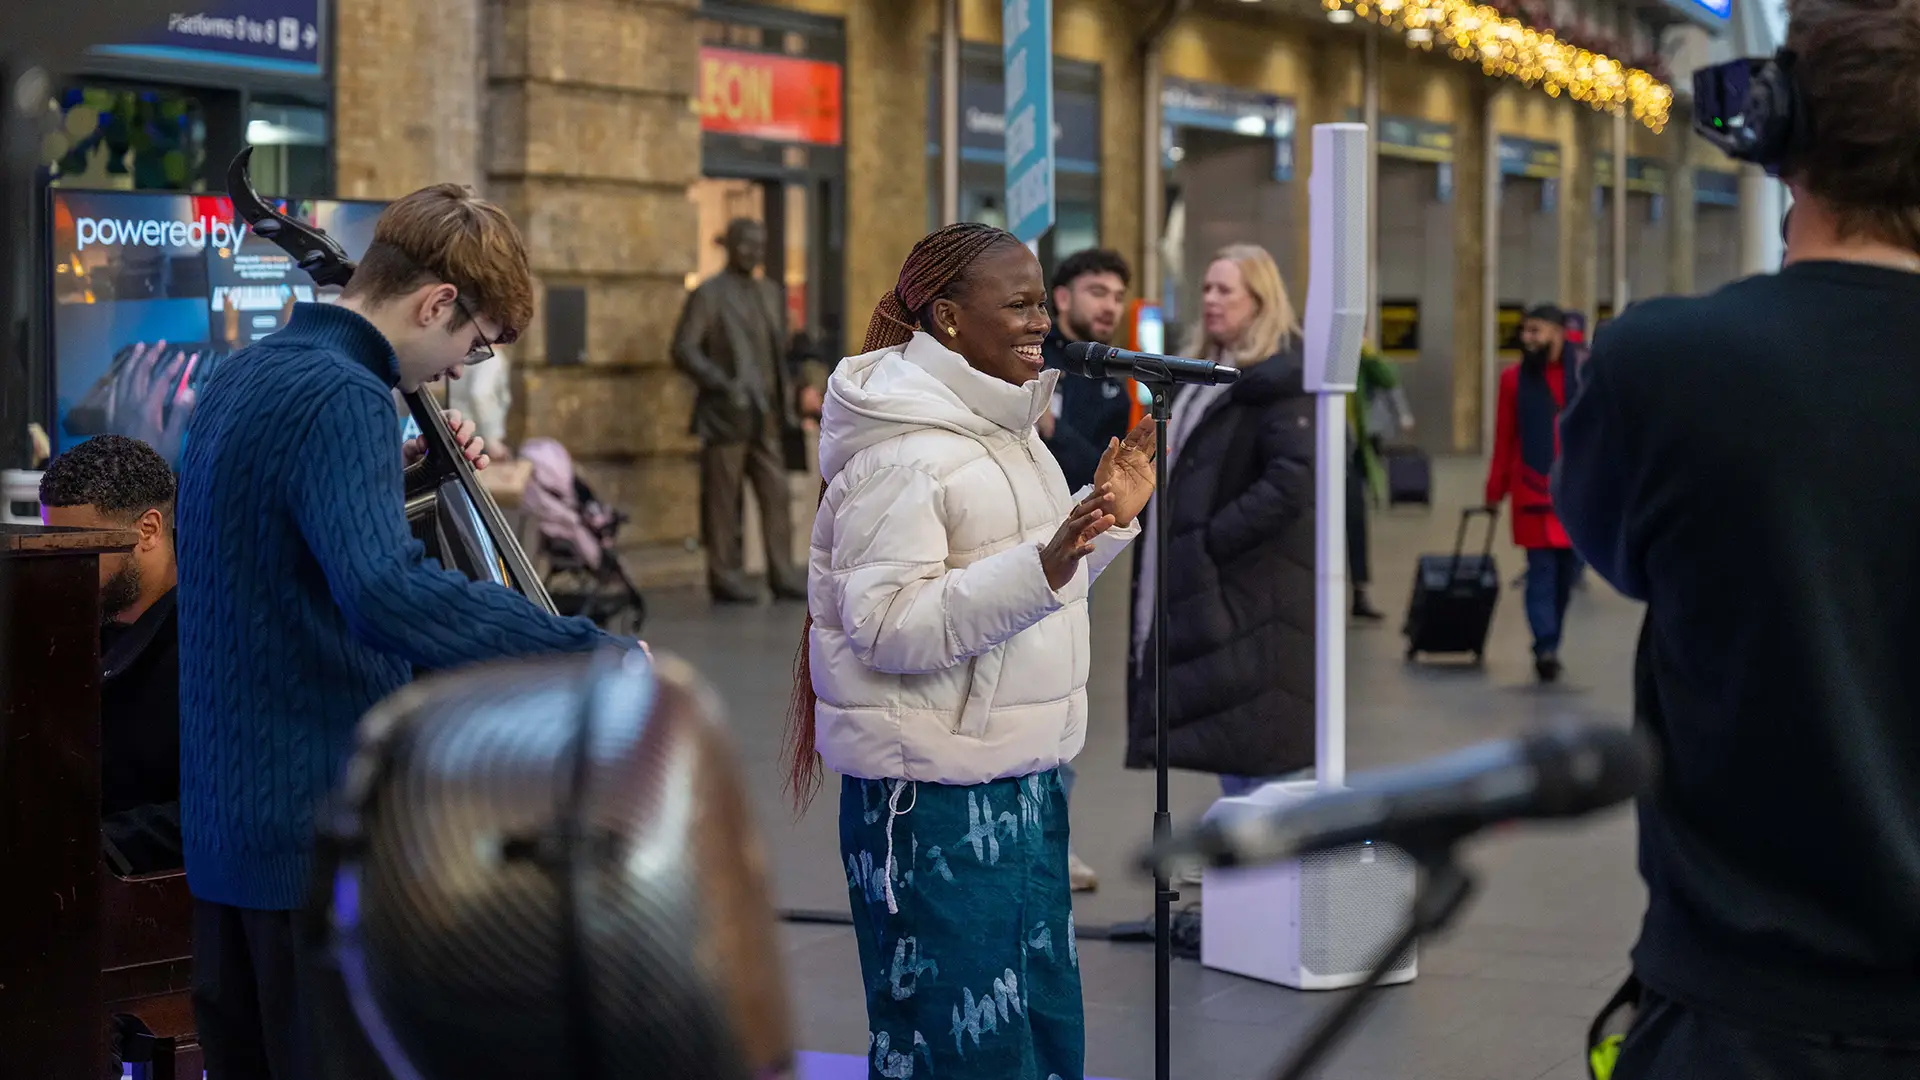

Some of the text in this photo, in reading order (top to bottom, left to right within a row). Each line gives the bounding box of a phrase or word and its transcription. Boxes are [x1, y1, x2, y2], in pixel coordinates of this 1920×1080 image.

[700, 58, 773, 124] EON
[77, 215, 247, 255] powered by
